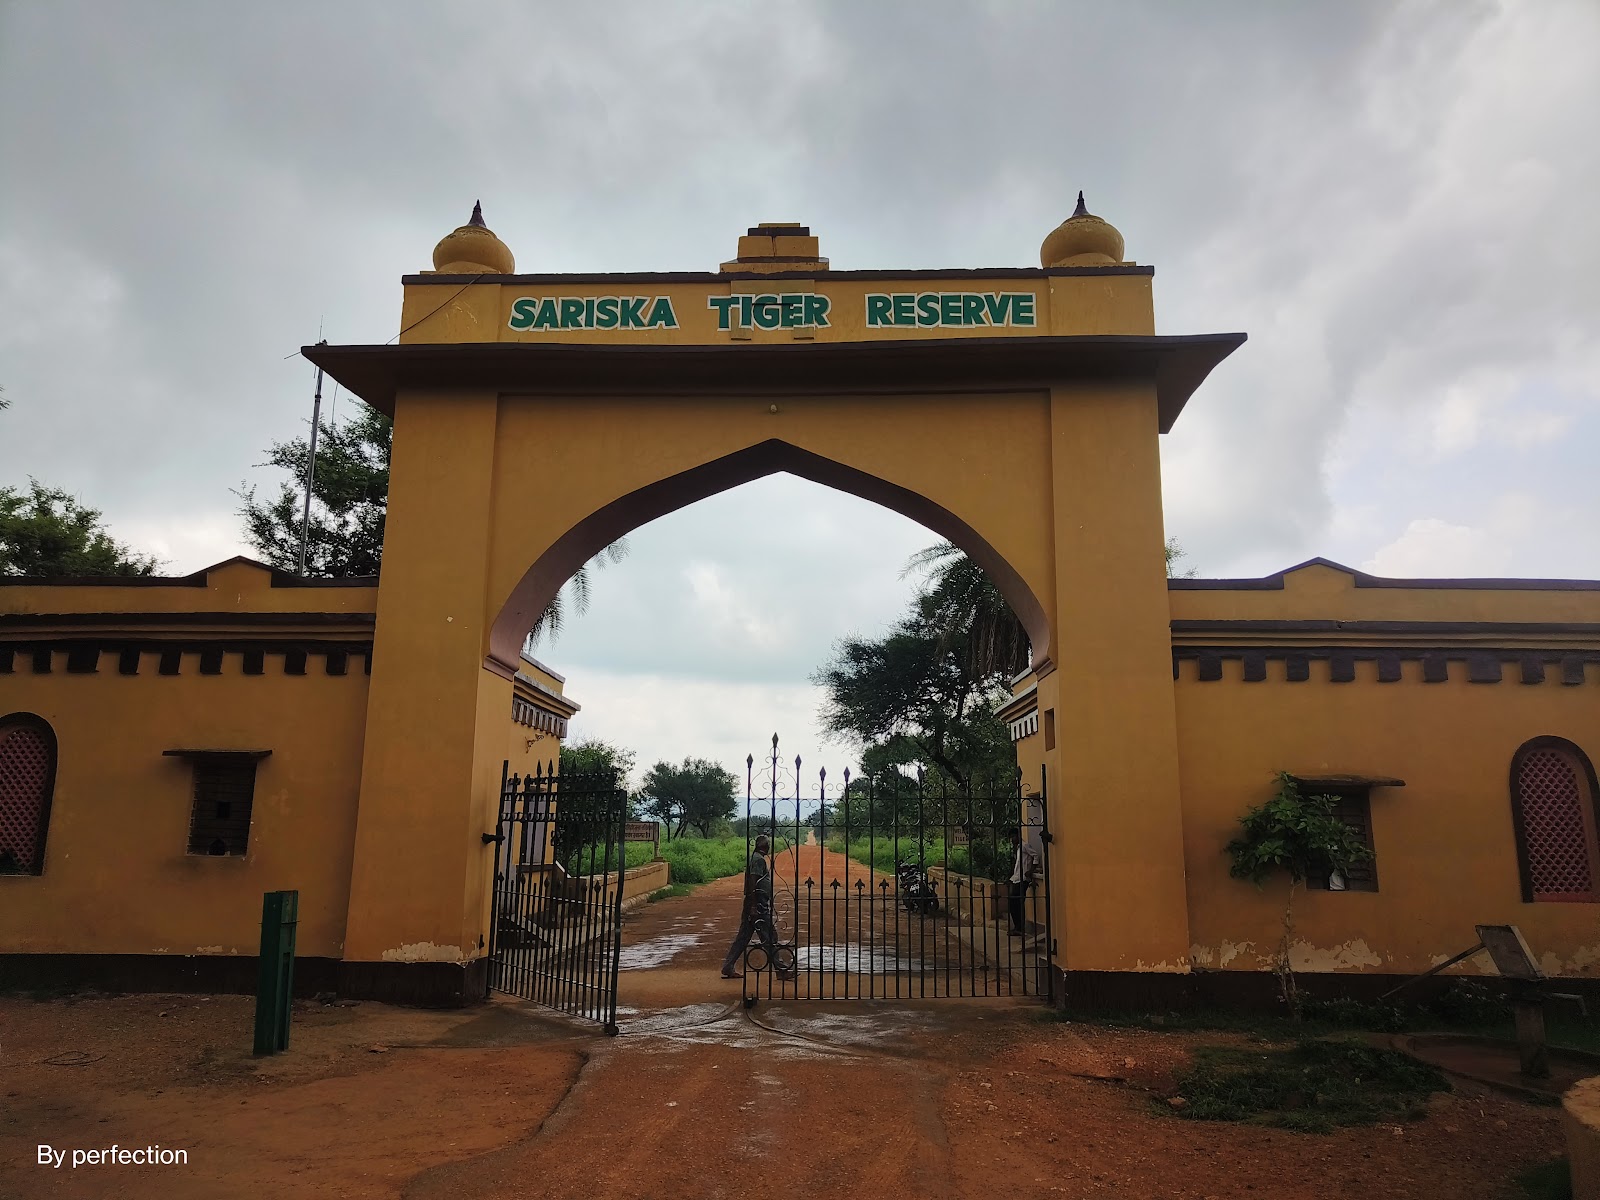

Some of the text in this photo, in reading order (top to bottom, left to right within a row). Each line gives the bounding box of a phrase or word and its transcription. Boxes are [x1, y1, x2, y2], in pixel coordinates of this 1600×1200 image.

[508, 292, 1037, 331] SARISKA TIGER RESERVE
